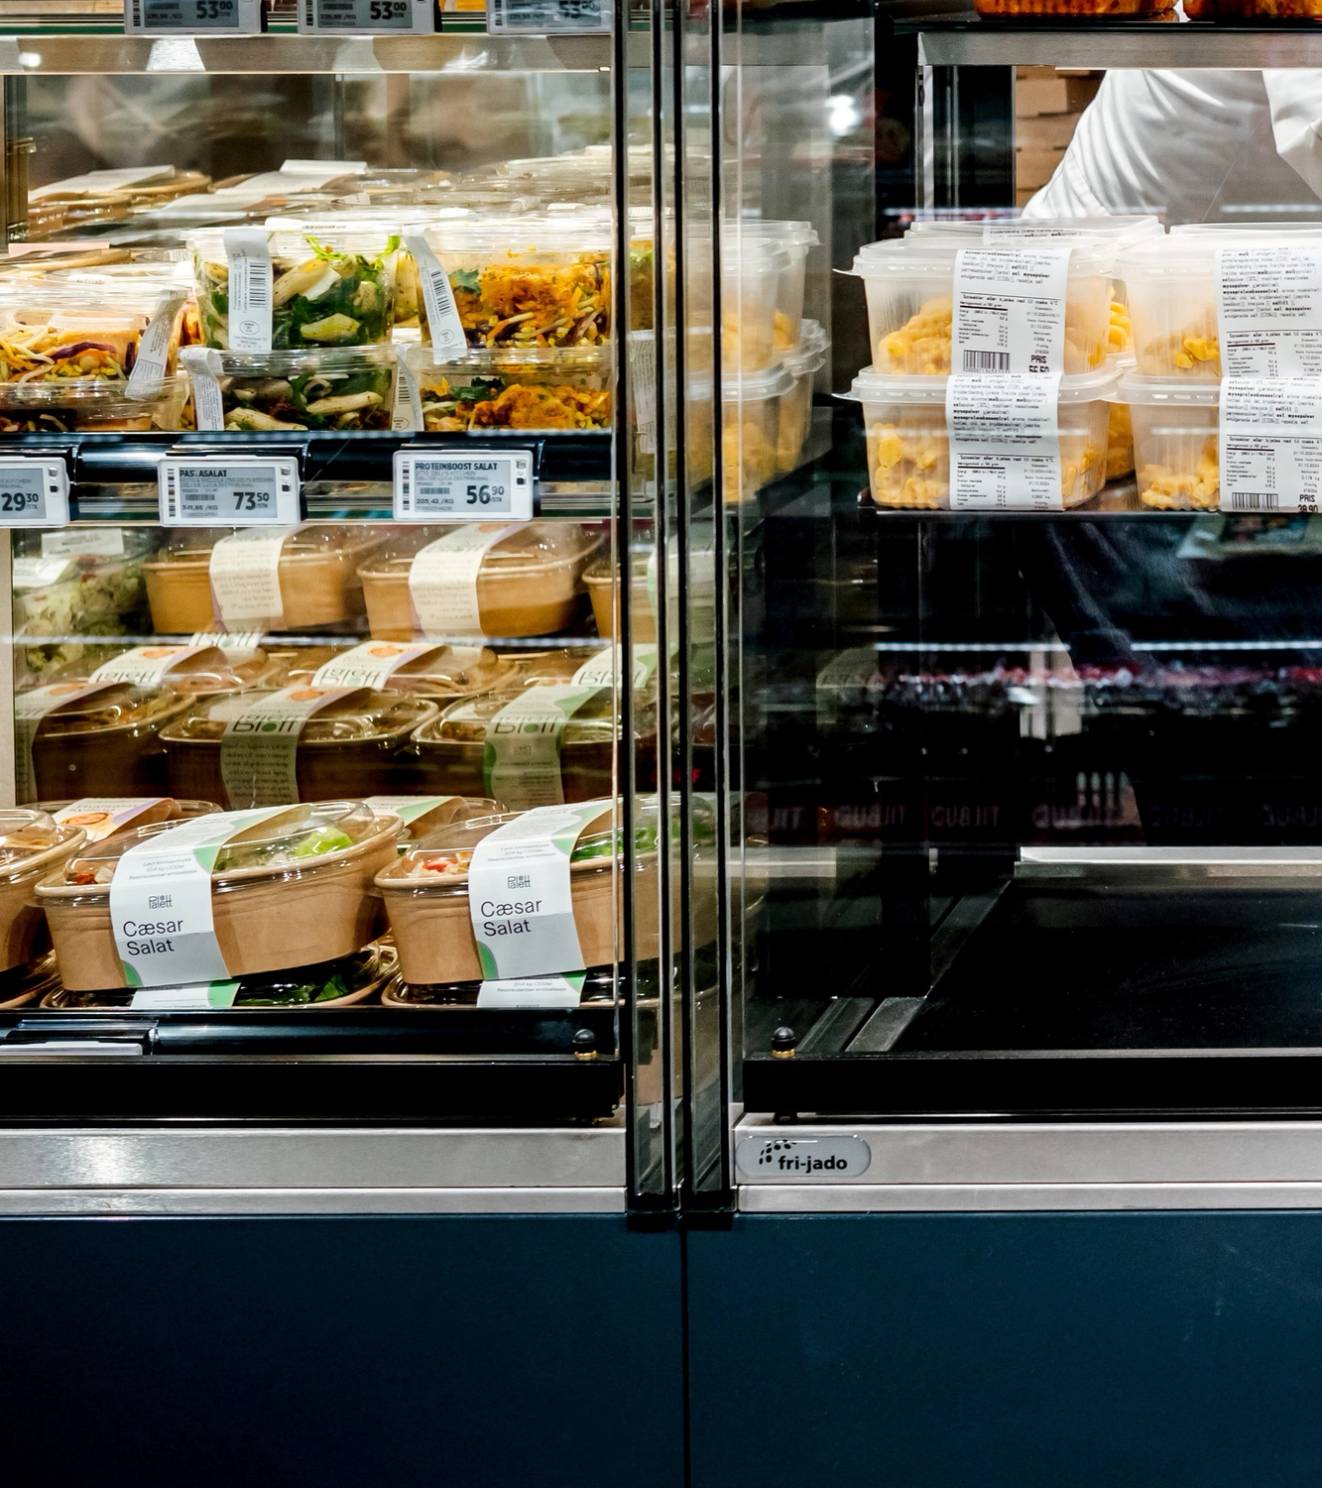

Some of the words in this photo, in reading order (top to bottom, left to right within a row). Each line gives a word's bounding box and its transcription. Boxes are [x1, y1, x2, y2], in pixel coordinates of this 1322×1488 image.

[1031, 355, 1047, 364] PRIS
[1299, 494, 1315, 503] PRIS
[481, 900, 542, 917] Cæsar
[123, 920, 183, 937] Cæsar
[484, 919, 531, 936] Salat
[127, 940, 174, 956] Salat
[778, 1155, 847, 1173] fri-jado
